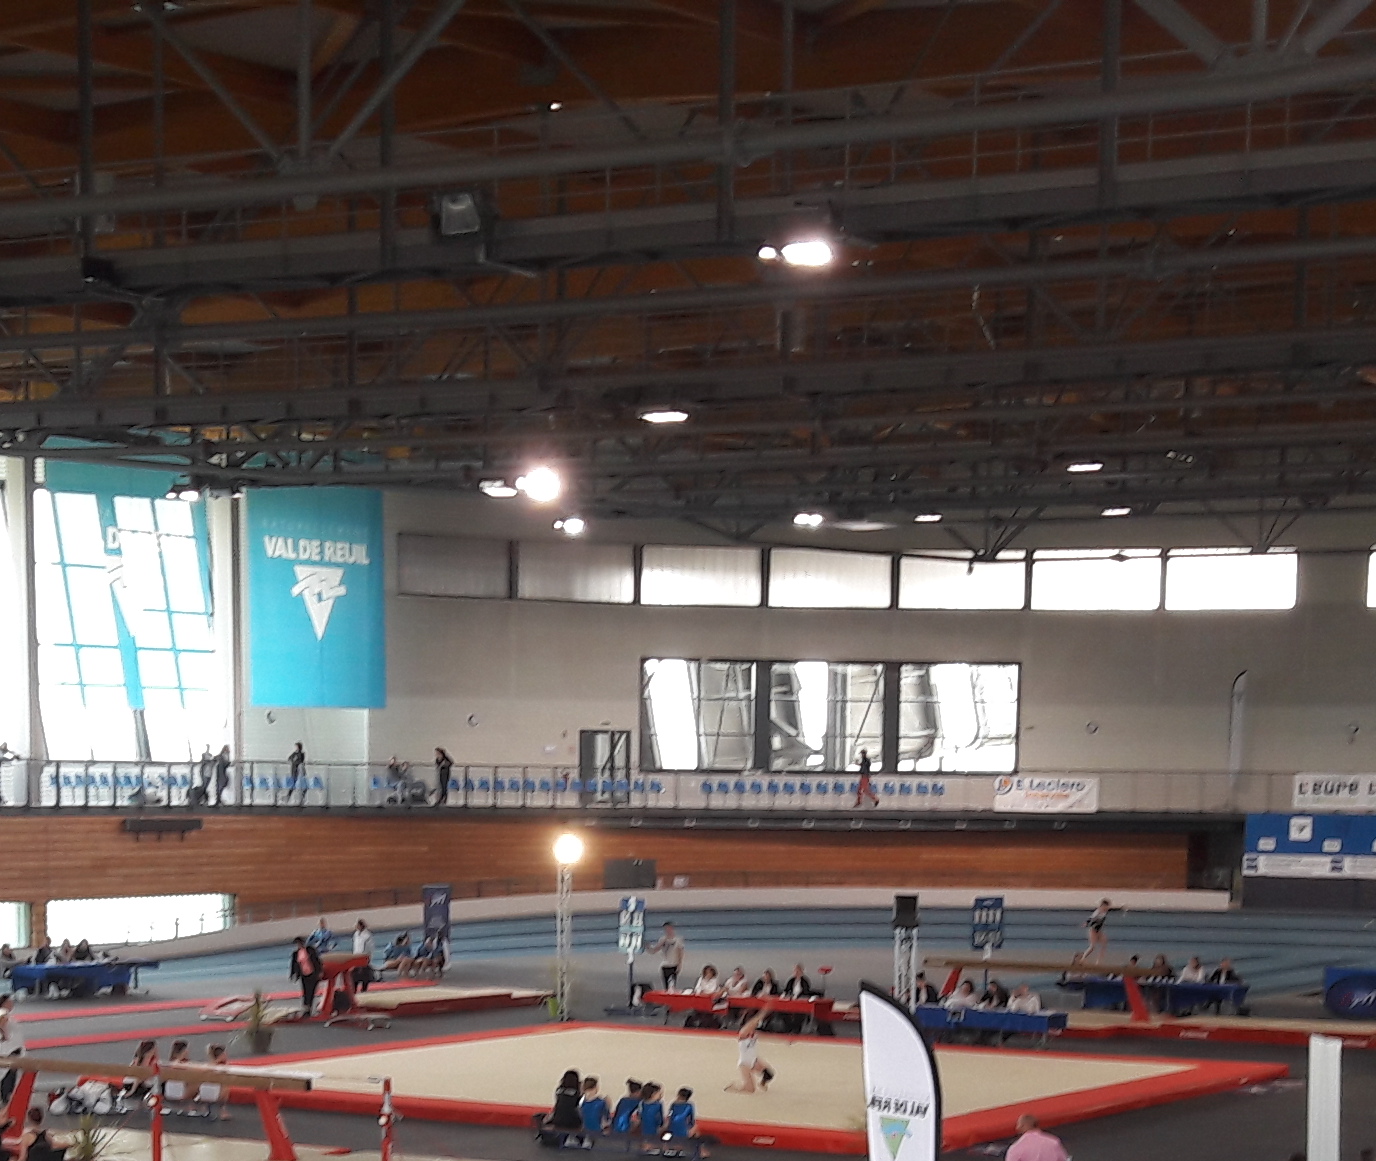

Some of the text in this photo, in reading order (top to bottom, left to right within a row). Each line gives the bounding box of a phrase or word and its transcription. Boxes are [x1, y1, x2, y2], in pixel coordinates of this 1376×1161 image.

[263, 535, 370, 565] VAL DE REUIL
